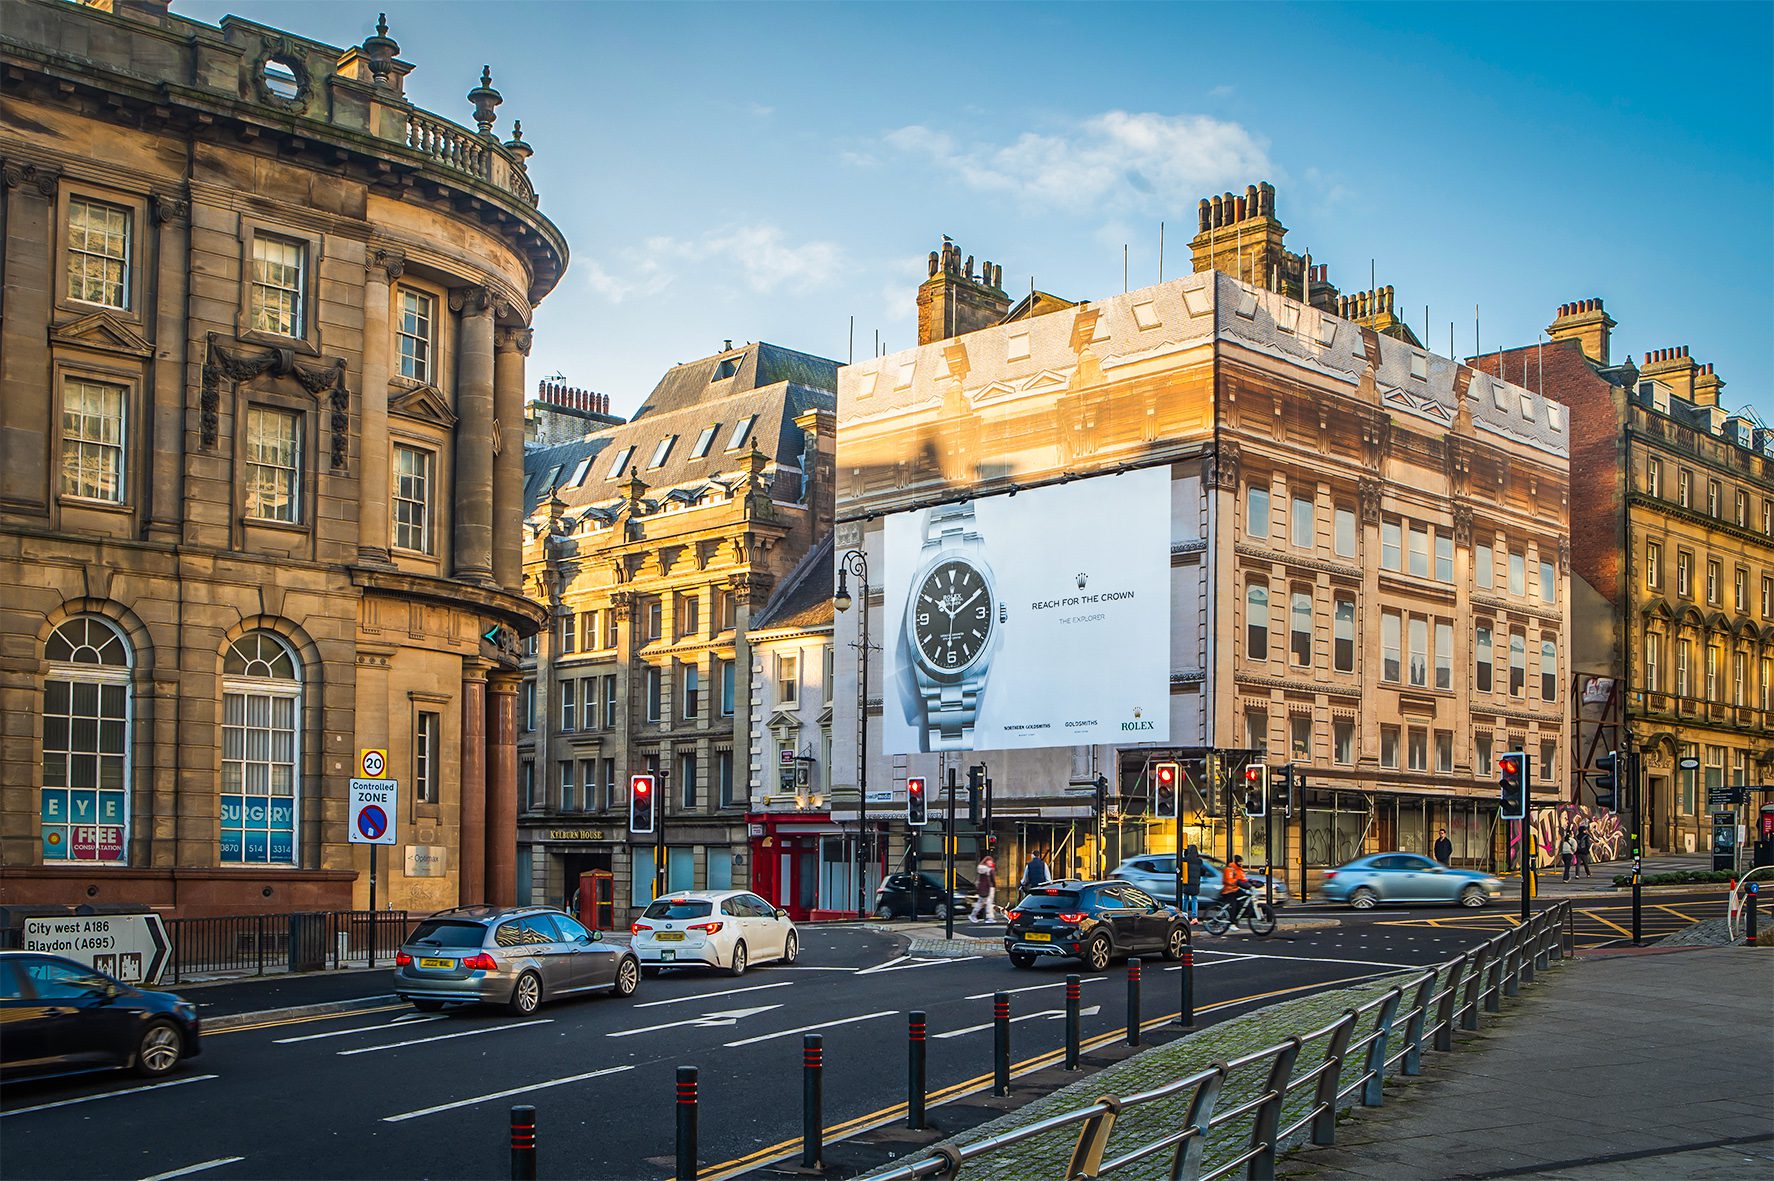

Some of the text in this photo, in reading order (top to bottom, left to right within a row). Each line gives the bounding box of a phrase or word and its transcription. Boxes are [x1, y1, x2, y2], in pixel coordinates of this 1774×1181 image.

[1031, 591, 1135, 610] REACH FOR THE CROWN
[919, 612, 930, 625] 9
[975, 606, 986, 619] 3
[1072, 613, 1105, 623] EXPLORER
[946, 651, 957, 664] 6
[1065, 719, 1098, 728] GOLDSMITHS
[1121, 721, 1154, 731] ROLEX
[366, 757, 382, 769] 20
[352, 781, 394, 791] Controlled
[358, 792, 387, 803] ZONE
[220, 804, 292, 822] SURGERY
[78, 827, 117, 844] FREE
[550, 830, 604, 839] KELBURN HOUSE
[220, 843, 291, 853] 0870 514 3314
[28, 921, 109, 936] City west A186
[28, 936, 115, 952] Blaydon (A695)
